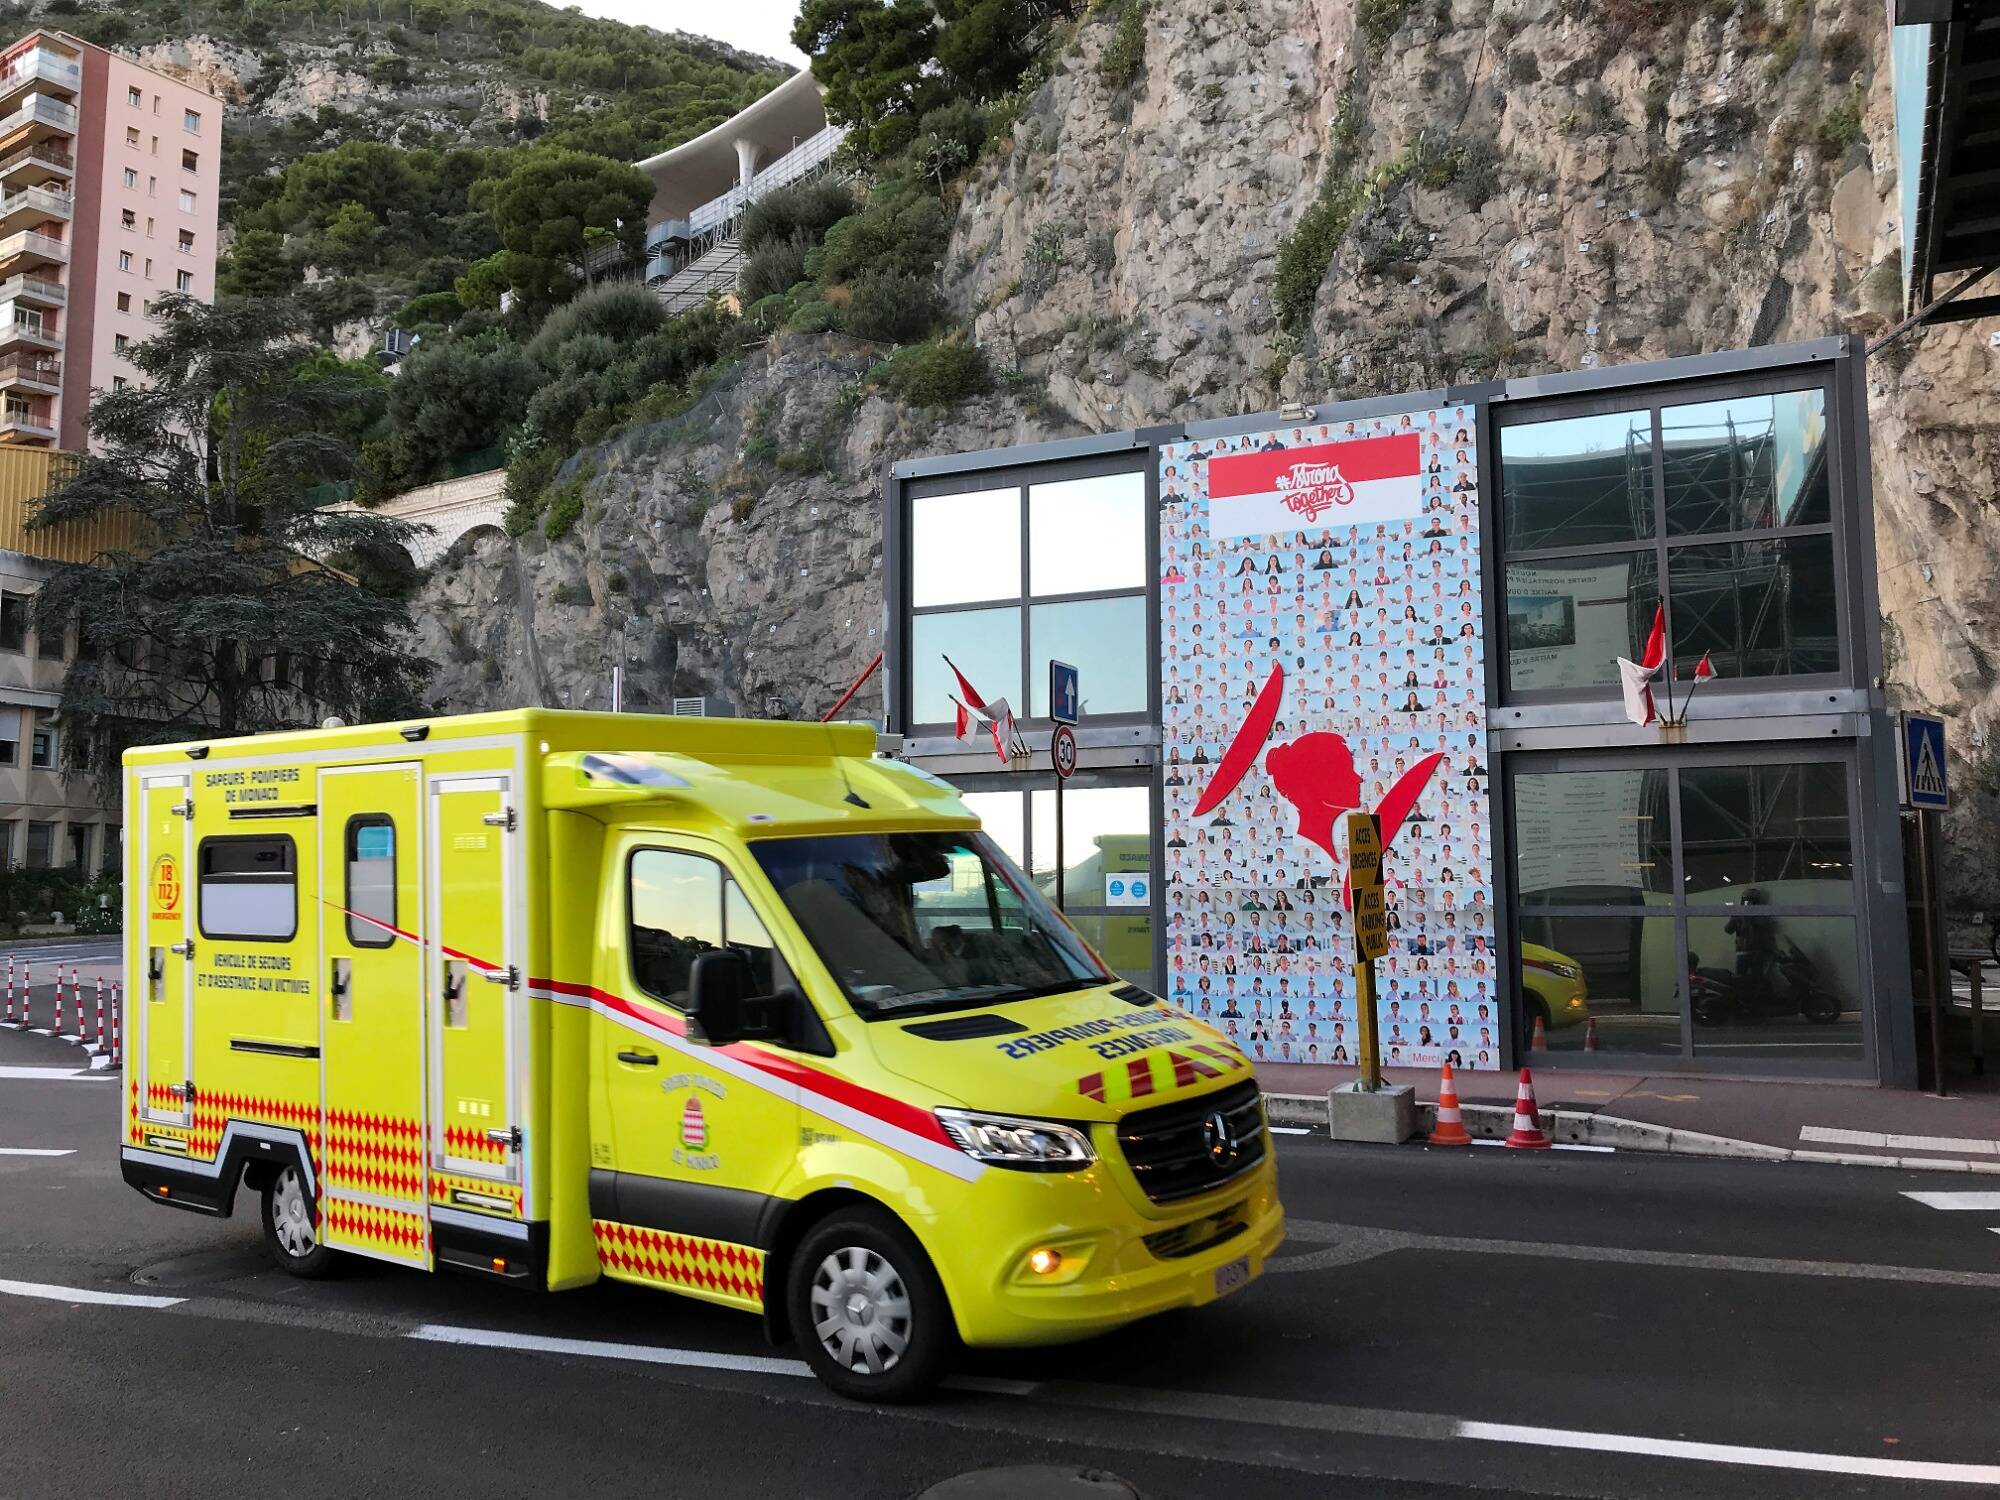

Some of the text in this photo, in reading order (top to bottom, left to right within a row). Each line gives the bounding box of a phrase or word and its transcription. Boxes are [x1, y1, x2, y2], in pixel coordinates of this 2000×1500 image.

[1059, 740, 1072, 764] 30
[225, 787, 278, 802] DE MONACO
[1351, 851, 1377, 870] URGENCES
[161, 864, 172, 881] 18
[158, 883, 173, 900] 112
[1361, 912, 1385, 932] PARKING
[1366, 932, 1383, 952] PUBLIC
[248, 955, 257, 969] DE
[259, 955, 291, 971] SECOURS
[198, 974, 207, 987] ET
[259, 976, 273, 991] AUX
[275, 978, 310, 994] VICTIMES
